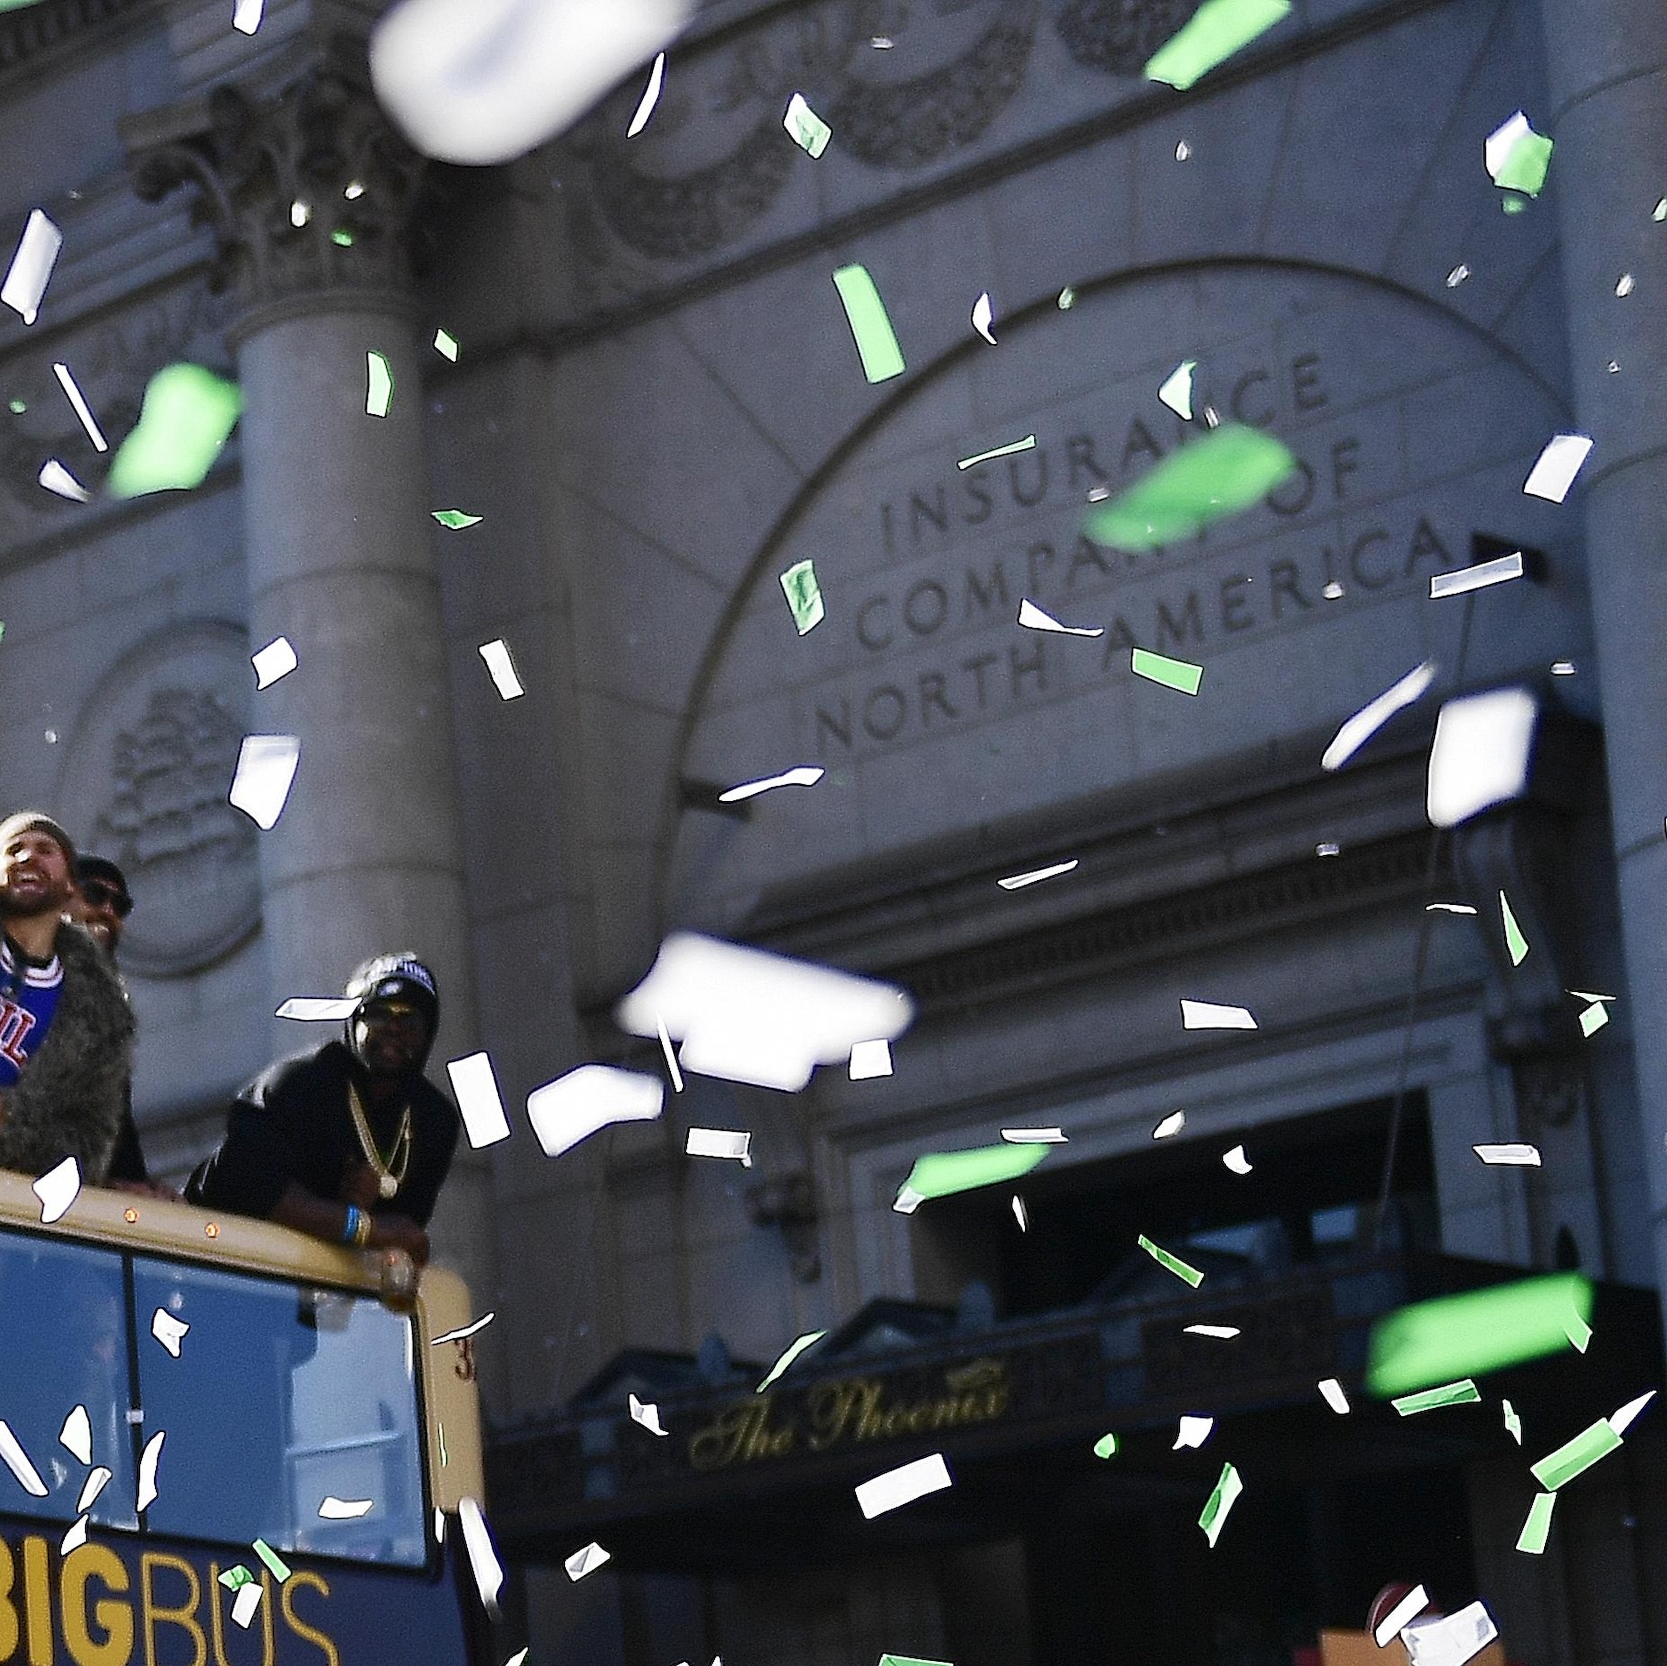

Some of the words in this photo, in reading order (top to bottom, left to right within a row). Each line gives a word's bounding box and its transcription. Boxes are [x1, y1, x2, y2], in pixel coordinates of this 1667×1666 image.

[813, 638, 1050, 756] NORTH
[1102, 523, 1453, 670] AMERICA
[856, 503, 1219, 654] COMPA
[1261, 438, 1360, 516] OF
[689, 1393, 799, 1472] The
[807, 1378, 1010, 1450] Phoenix
